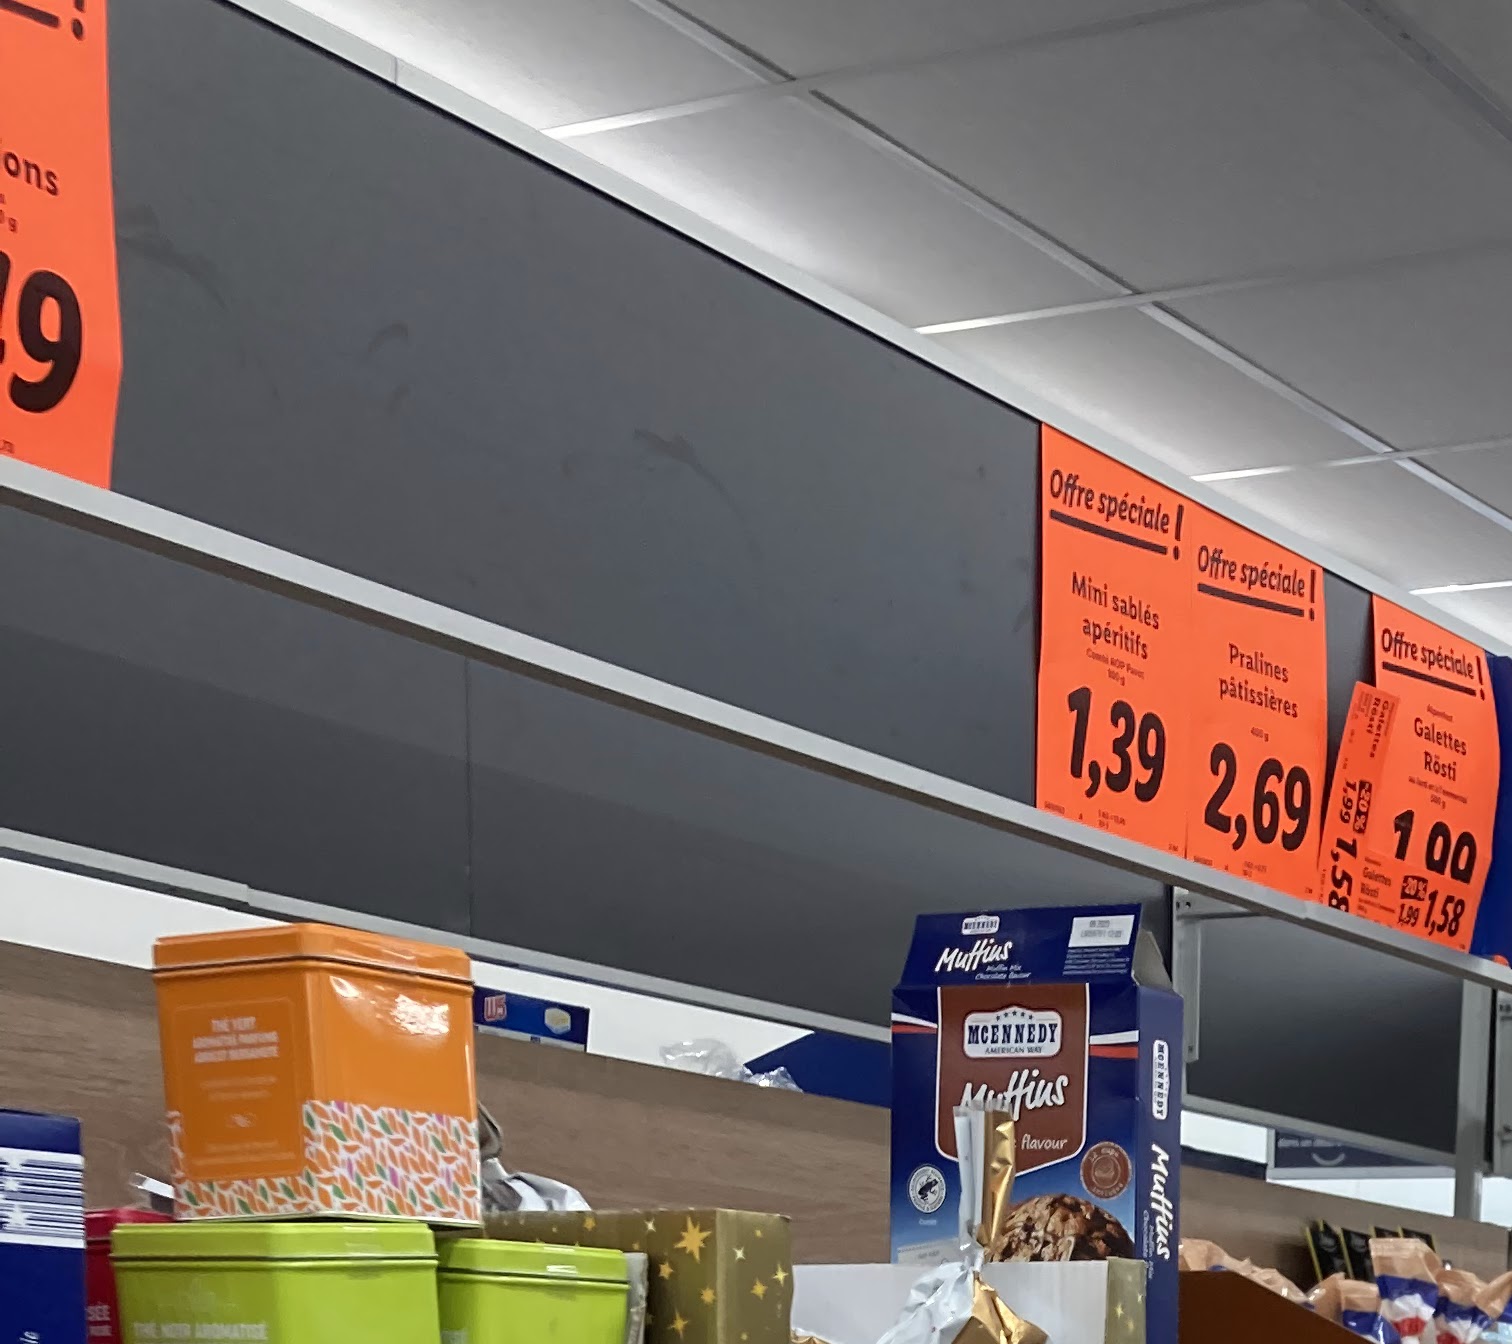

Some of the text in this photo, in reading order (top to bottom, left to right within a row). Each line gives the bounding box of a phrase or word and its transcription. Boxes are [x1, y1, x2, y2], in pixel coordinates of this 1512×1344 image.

[1050, 467, 1094, 511] Offre
[1097, 484, 1170, 536] spéciale
[1198, 545, 1237, 583] Offre
[1240, 559, 1305, 600] spéciale
[1071, 571, 1160, 630] Mini sablés
[1082, 616, 1149, 660] apéritifs
[1228, 643, 1290, 684] Pralines
[1219, 675, 1298, 719] pâtissières
[1065, 684, 1167, 803] 1,39
[1413, 717, 1468, 756] Galettes
[1424, 751, 1457, 782] Rösti
[1203, 742, 1312, 852] 2,69
[1424, 889, 1466, 938] 1,58
[934, 938, 1014, 974] Muffins
[967, 1021, 1059, 1045] MCENNEDY
[1020, 1133, 1068, 1150] flavour
[1150, 1143, 1170, 1260] Muffins
